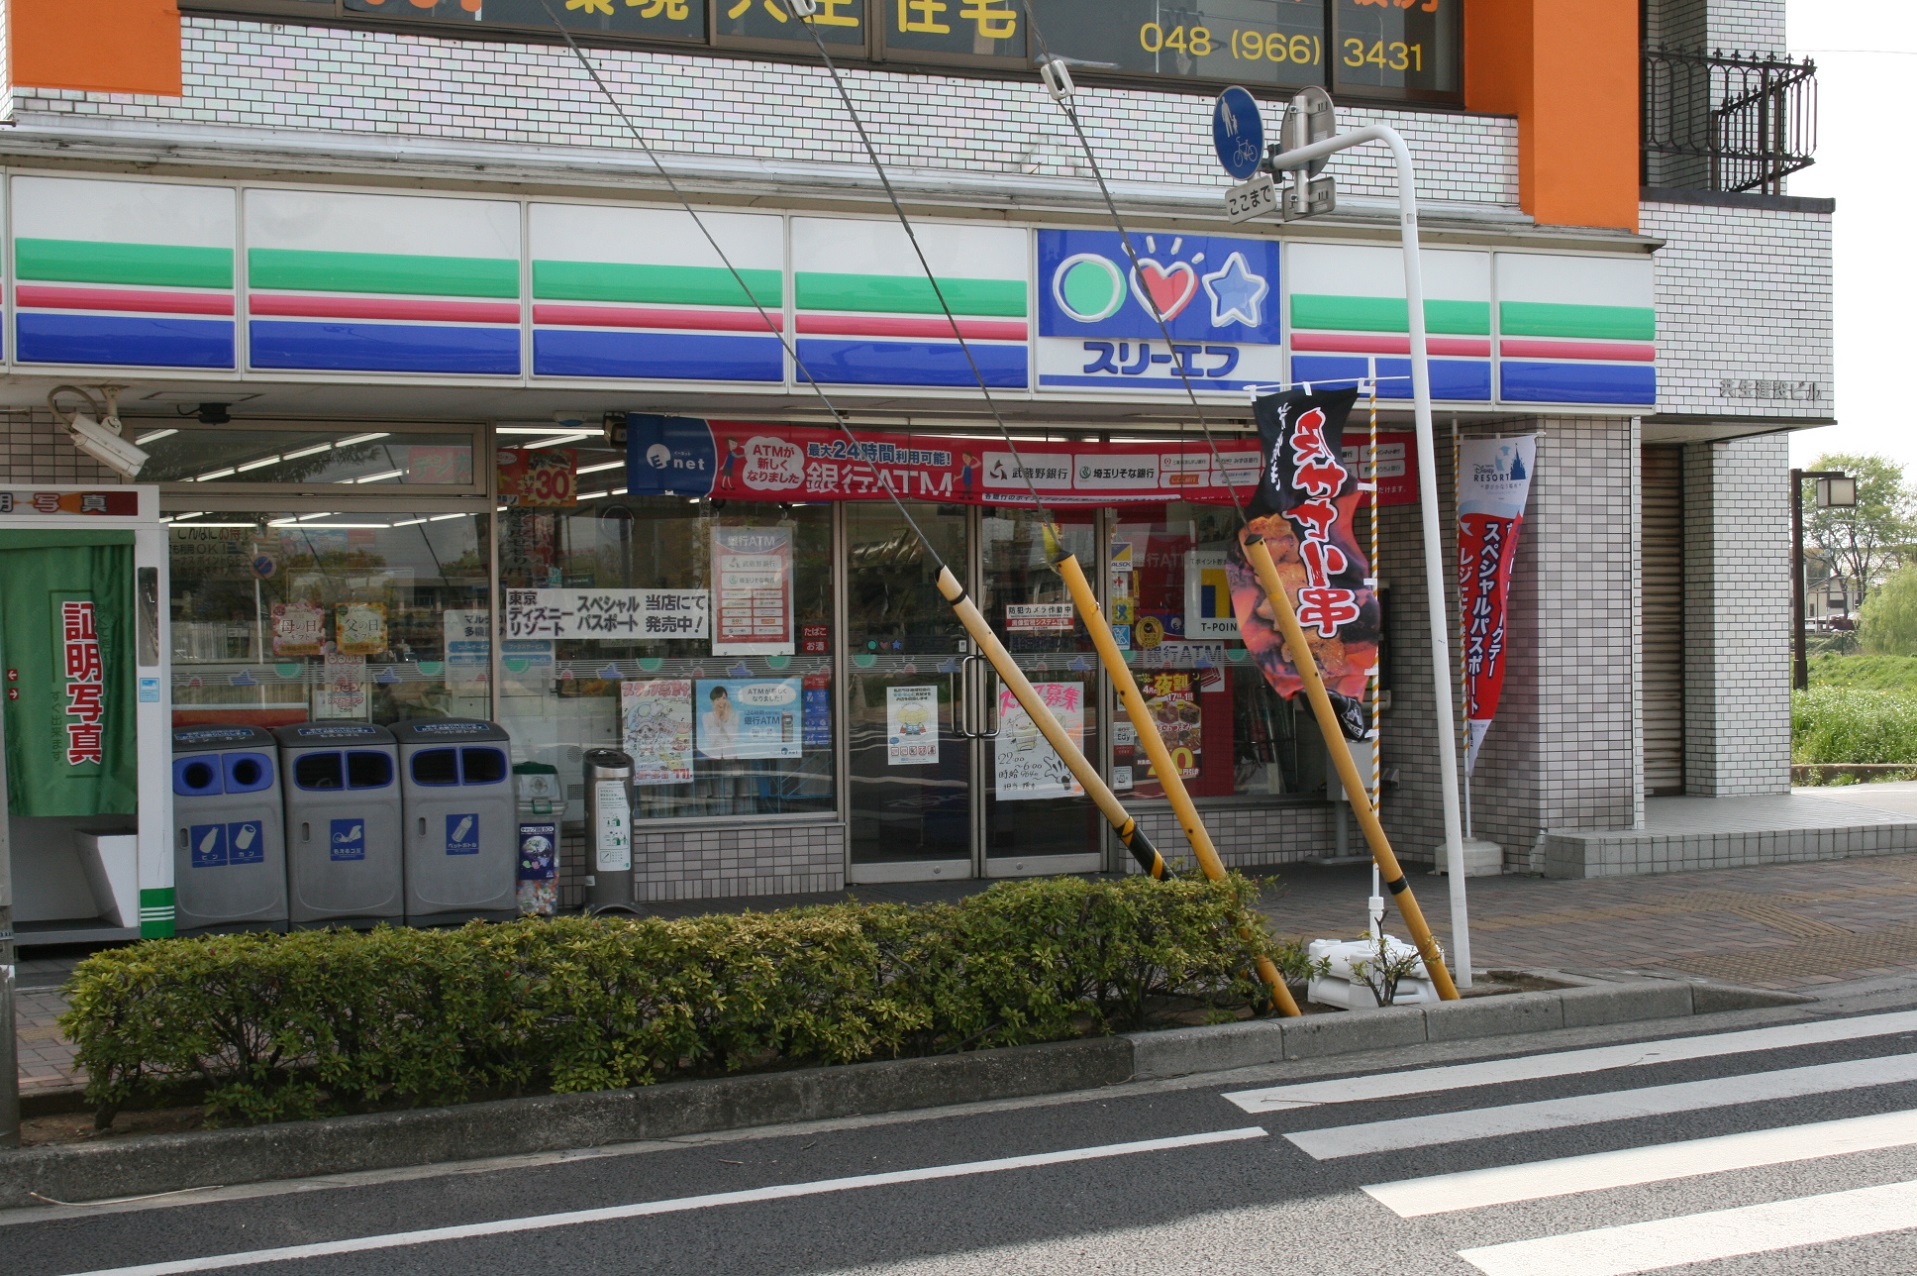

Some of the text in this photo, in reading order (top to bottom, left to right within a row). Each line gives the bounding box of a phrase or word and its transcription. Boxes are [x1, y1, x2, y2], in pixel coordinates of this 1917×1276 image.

[1140, 22, 1422, 71] 048 (966) 3431
[1228, 184, 1271, 216] ここまで
[1083, 341, 1240, 377] スリーエフ
[1719, 379, 1822, 402] 共生建設ビル
[753, 444, 795, 458] ATMが
[674, 458, 704, 470] net
[757, 458, 787, 471] 新しく
[746, 470, 800, 484] なりました
[806, 462, 954, 497] 銀行ATM
[1012, 467, 1068, 480] 武蔵野銀行
[1093, 468, 1155, 480] 埼玉りそな銀行
[1473, 474, 1510, 482] RESORT
[728, 536, 775, 547] 銀行ATM
[509, 590, 537, 605] 東京
[577, 595, 640, 613] スペシャル
[646, 594, 706, 611] 当店にて
[509, 607, 574, 622] ディズニー
[1009, 606, 1072, 614] 防犯カメラ作動中
[345, 619, 379, 632] 父の日
[577, 613, 639, 632] パスポート
[646, 616, 703, 633] 発売中!
[1468, 522, 1501, 715] スペシャルパスポート
[282, 619, 317, 633] 母の日
[511, 622, 565, 636] リゾート
[804, 627, 827, 636] たばこ
[1201, 622, 1237, 631] T-POIN
[806, 642, 825, 651] お酒
[62, 601, 104, 766] 証明写真
[1155, 673, 1189, 695] 夜割
[999, 683, 1080, 717] スフ募集
[744, 716, 780, 725] 銀行ATM
